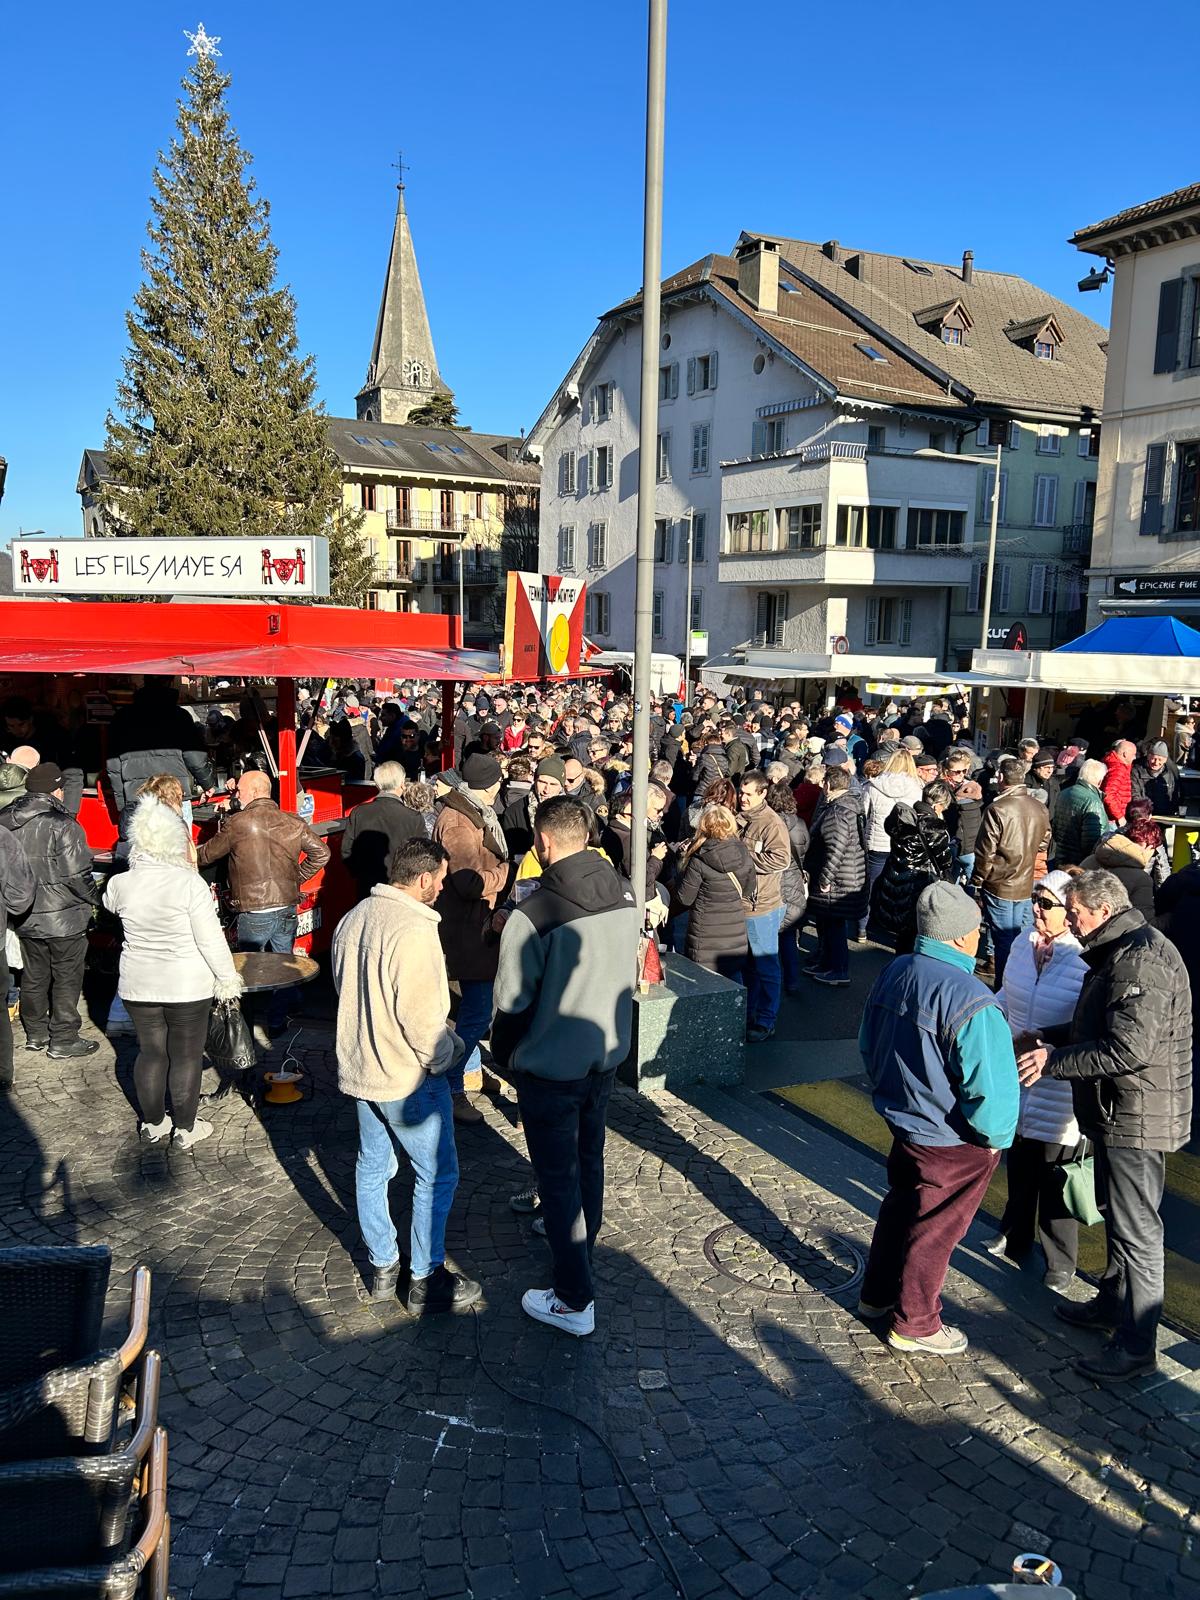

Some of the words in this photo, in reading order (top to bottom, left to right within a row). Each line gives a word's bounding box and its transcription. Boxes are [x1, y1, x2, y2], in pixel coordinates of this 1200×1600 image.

[75, 555, 109, 576] LES
[113, 554, 150, 576] FILS
[147, 554, 215, 584] MAYE
[220, 555, 242, 578] SA
[1139, 581, 1176, 590] EPICERIE
[1179, 580, 1199, 589] FINE
